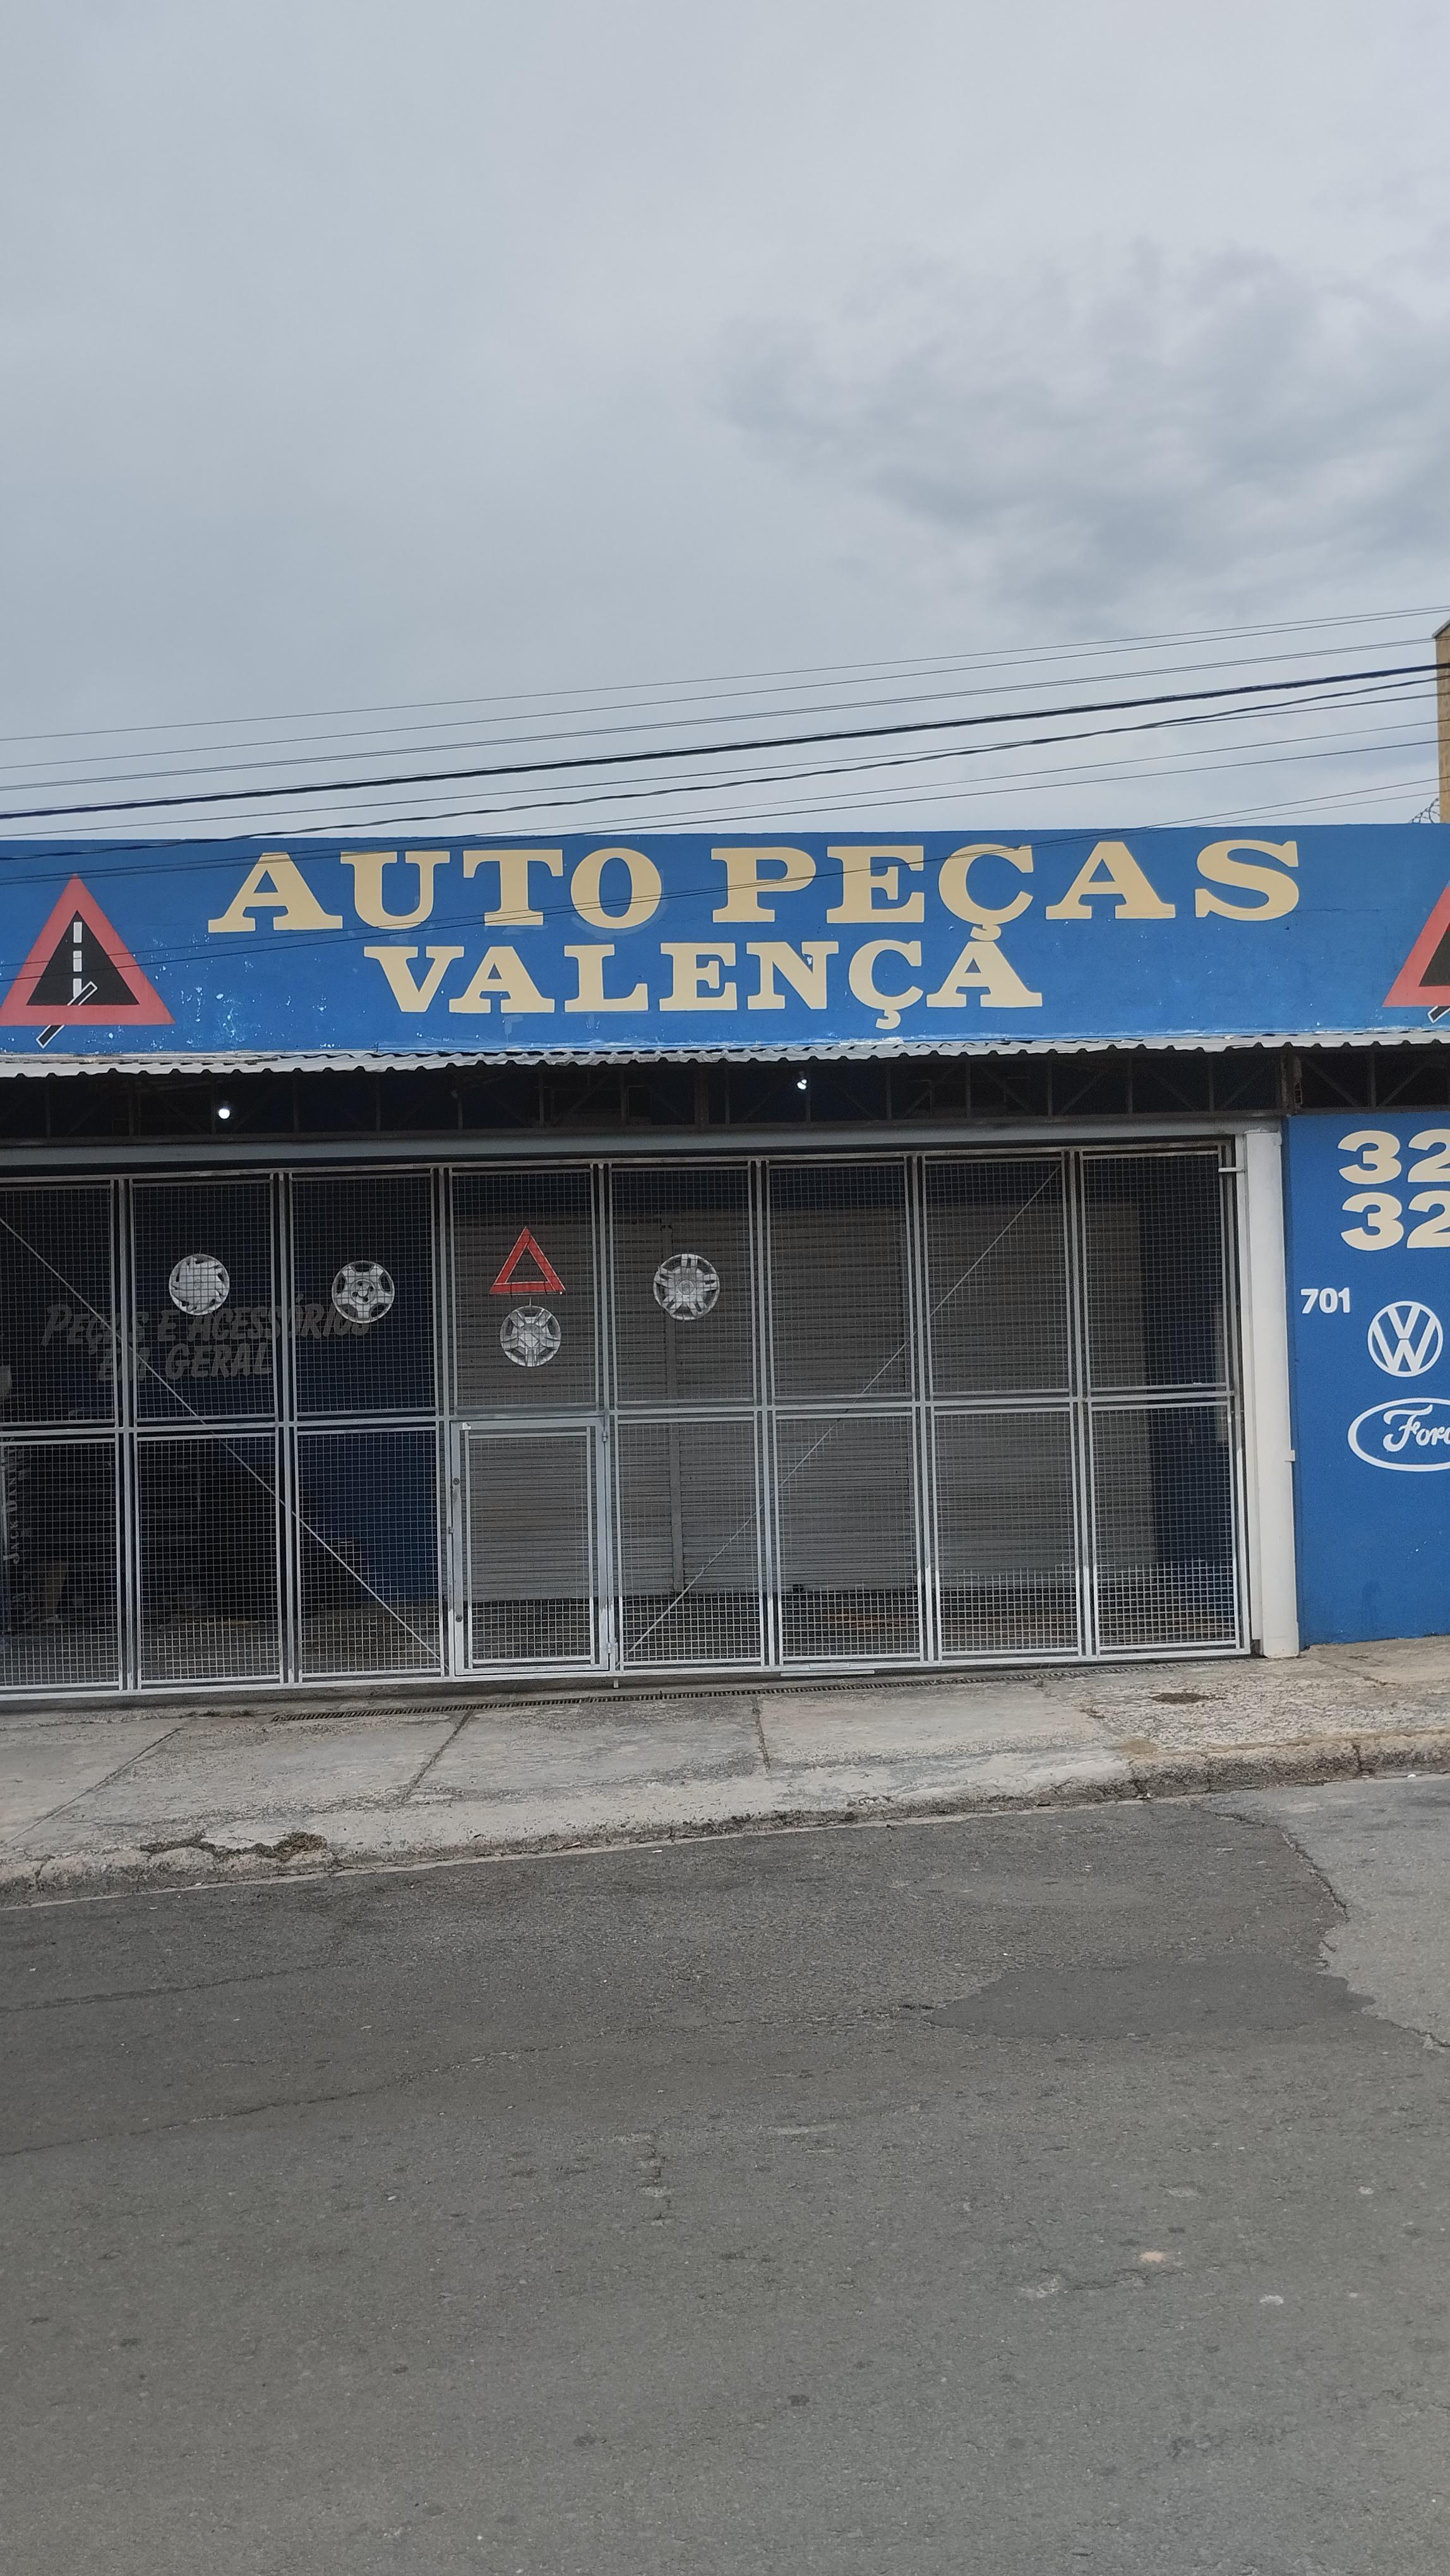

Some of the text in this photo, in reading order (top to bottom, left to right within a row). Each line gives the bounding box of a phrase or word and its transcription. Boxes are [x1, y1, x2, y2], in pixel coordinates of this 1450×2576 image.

[208, 840, 1300, 941] AUTO PEÇAS
[363, 940, 1043, 1030] VALENÇA
[1338, 1129, 1450, 1184] 32
[1341, 1190, 1450, 1251] 32
[158, 1309, 180, 1341] E
[1300, 1287, 1350, 1314] 701
[165, 1343, 273, 1380] GERAL
